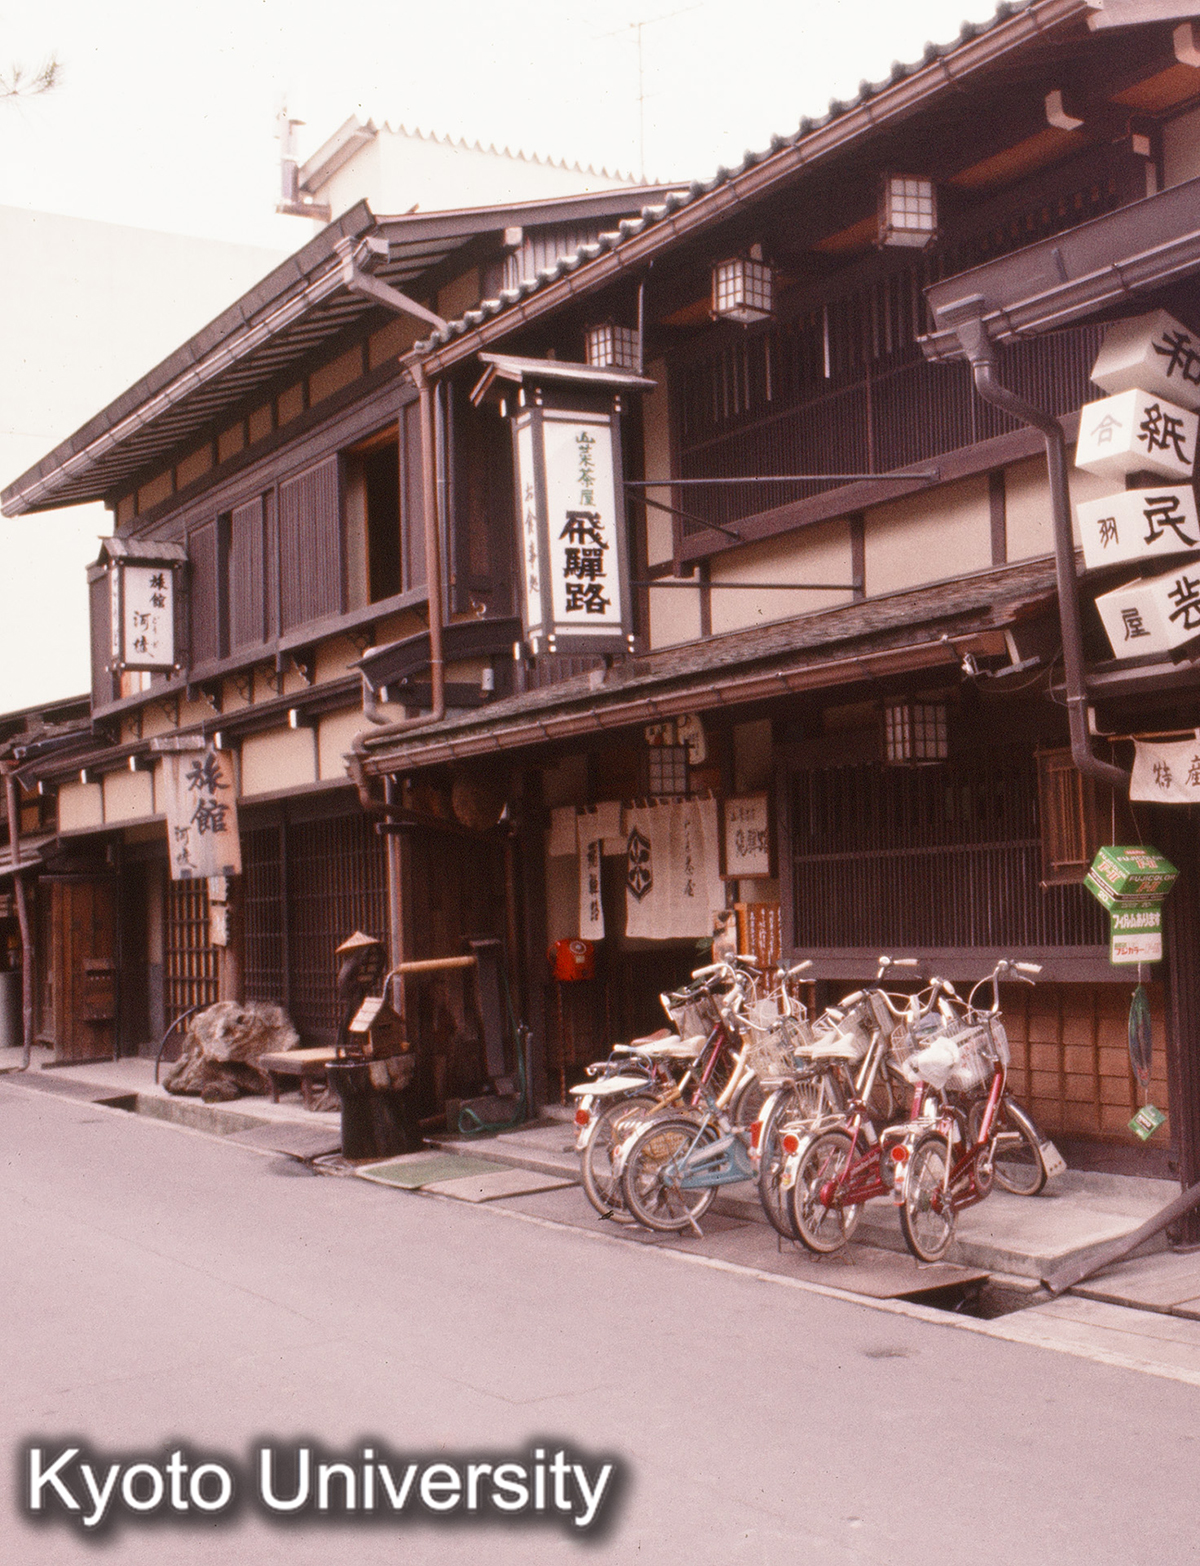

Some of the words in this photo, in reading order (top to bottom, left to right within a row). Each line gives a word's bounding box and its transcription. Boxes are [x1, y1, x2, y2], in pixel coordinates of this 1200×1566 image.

[575, 430, 597, 507] 山菜茶屋
[148, 572, 168, 608] 旅館
[186, 751, 230, 835] 旅館
[1128, 873, 1176, 882] FUJICOLOR
[1112, 911, 1161, 930] フィルムあります
[1114, 946, 1145, 956] フジカラー
